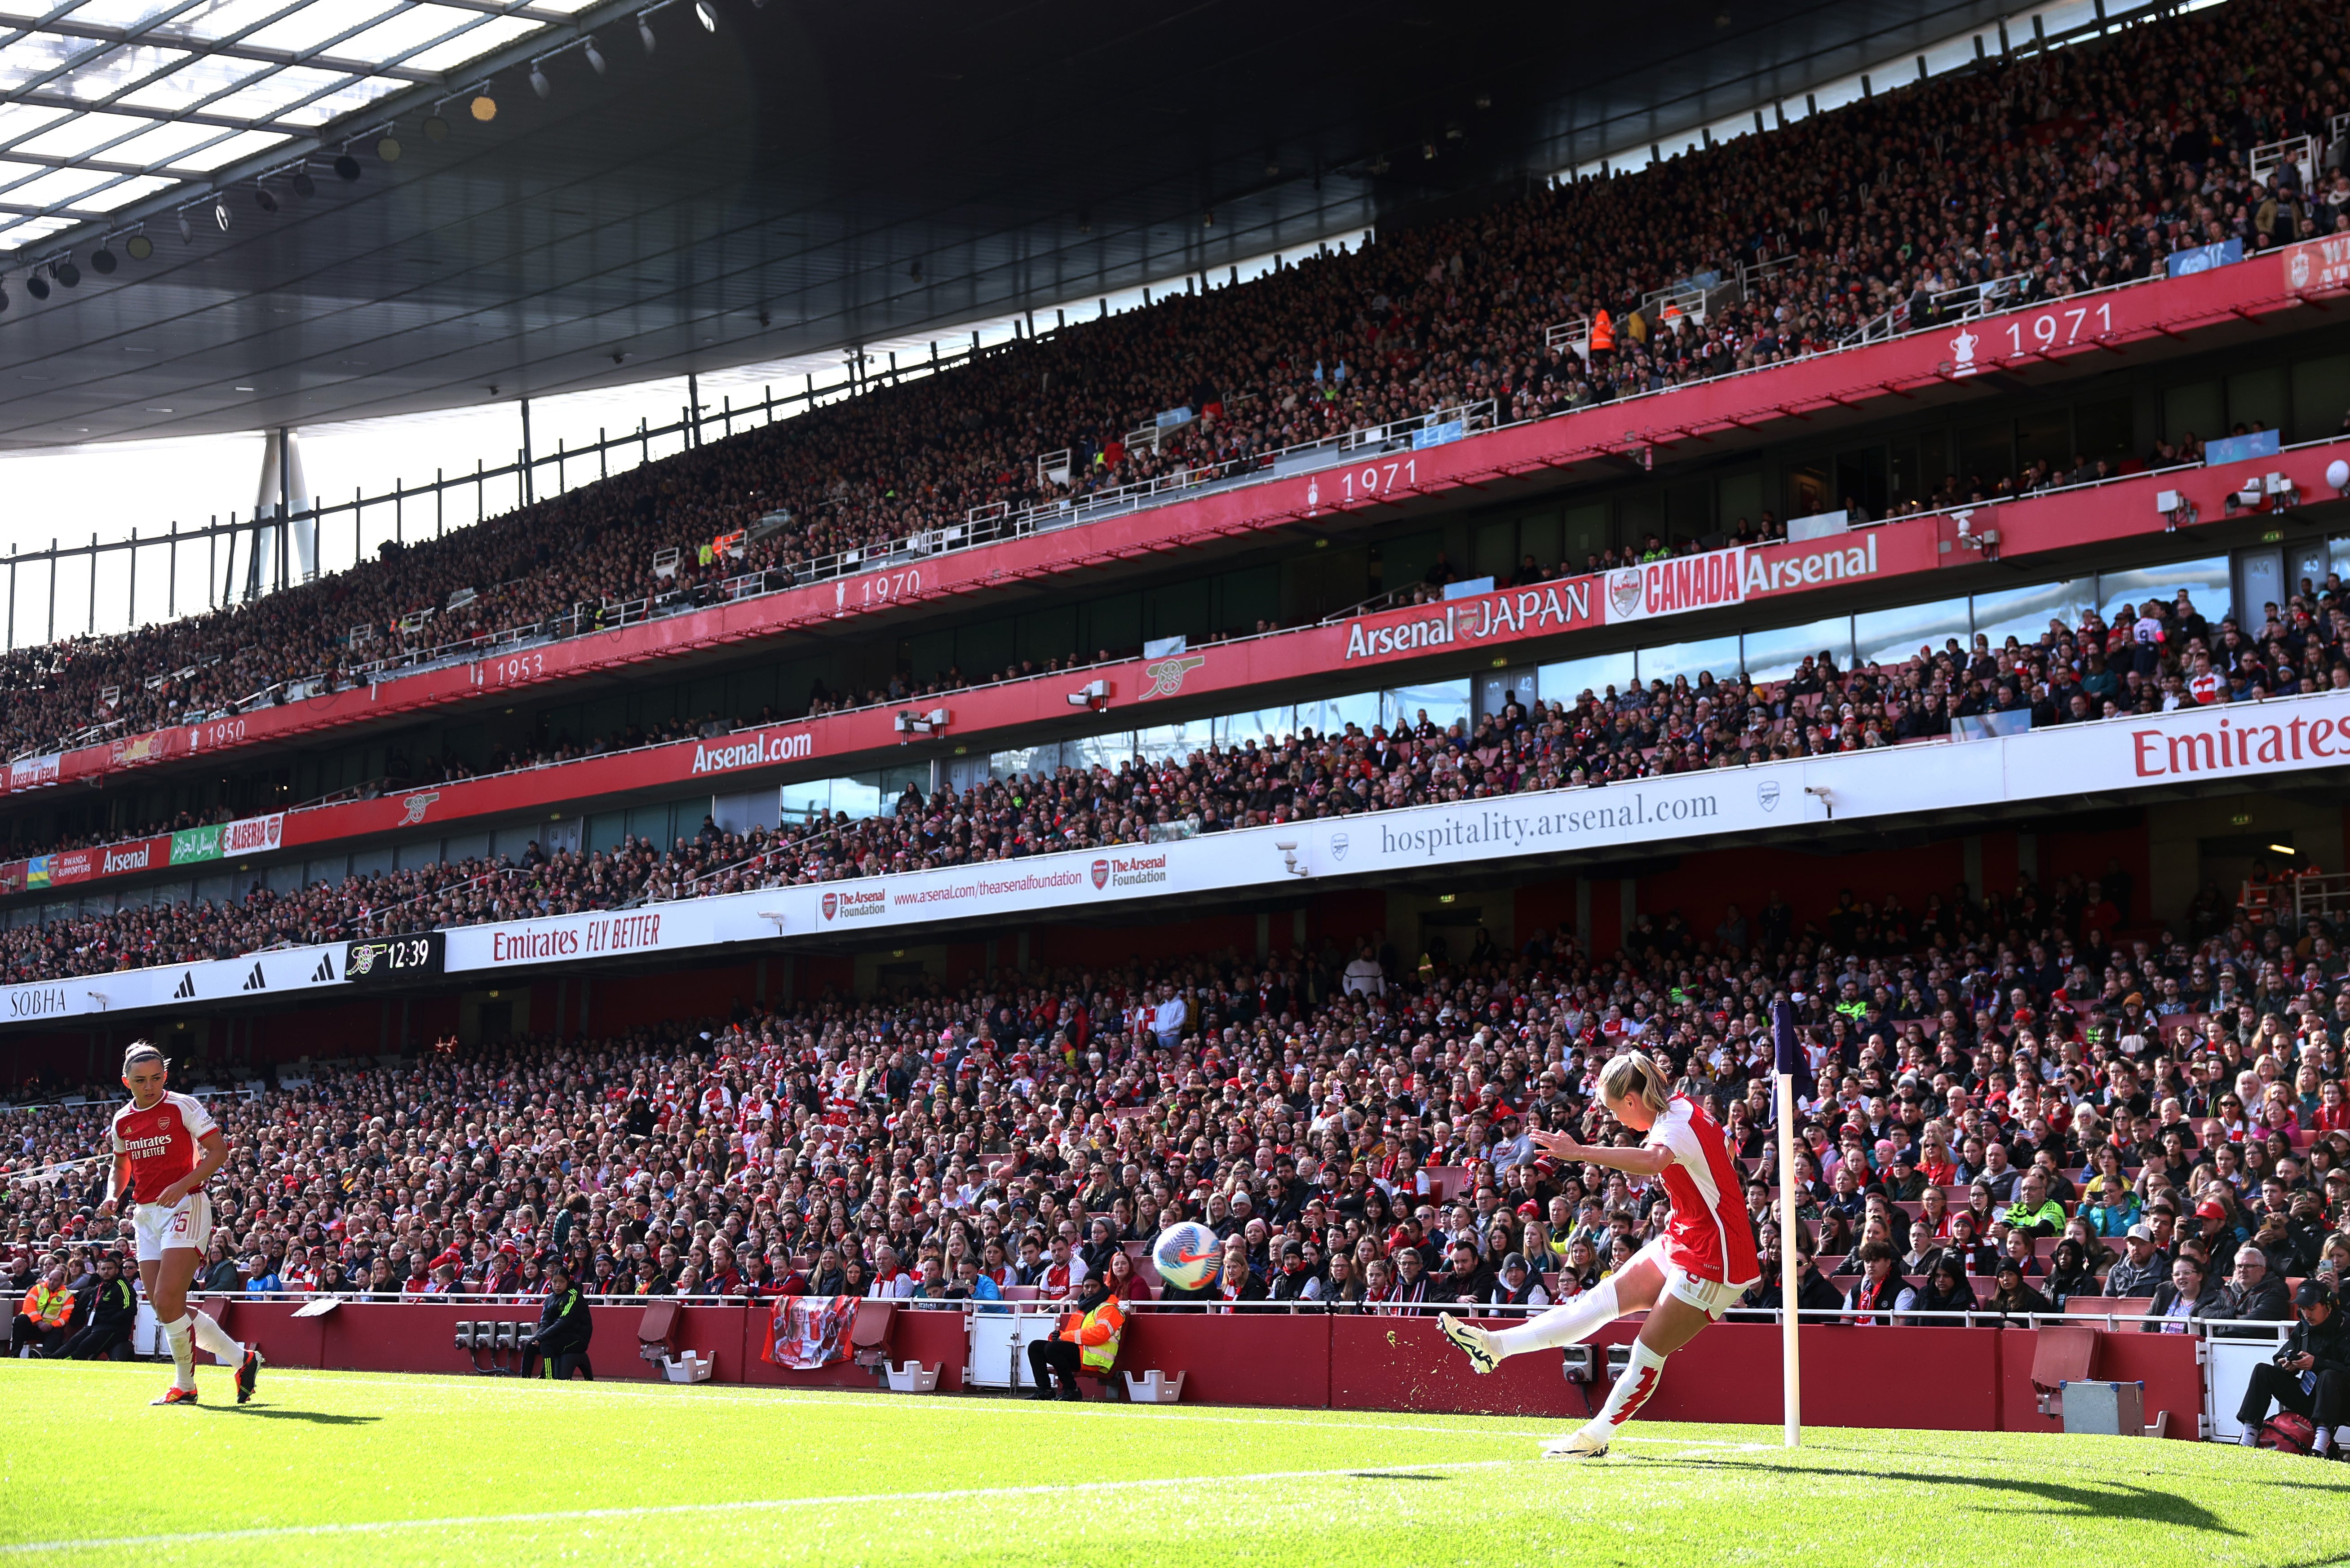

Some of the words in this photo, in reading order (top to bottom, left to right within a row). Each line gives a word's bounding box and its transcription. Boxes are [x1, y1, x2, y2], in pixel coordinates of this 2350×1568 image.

[2005, 302, 2115, 358] 1971
[1342, 459, 1415, 502] 1971
[1744, 533, 1877, 594] Arsenal
[862, 570, 920, 607] 1970
[1646, 552, 1739, 614] CANADA
[1345, 607, 1454, 660] Arsenal
[1474, 581, 1590, 638] JAPAN
[497, 654, 542, 686] 1953
[208, 720, 245, 748] 1950
[691, 733, 811, 774] Arsenal.com
[231, 821, 266, 850] ALGERIA
[1381, 793, 1719, 856] hospitality.arsenal.com
[58, 864, 91, 877] SUPPORTERS
[64, 855, 87, 865] RWANDA
[102, 843, 149, 874] Arsenal
[1111, 859, 1129, 873] The
[1129, 853, 1166, 871] Arsenal
[894, 870, 1082, 906] www.arsenal.com/thearsenalfoundation
[1112, 869, 1166, 887] Foundation
[839, 892, 854, 906] The
[854, 888, 885, 904] Arsenal
[840, 903, 885, 918] Foundation
[494, 927, 578, 961] Emirates
[586, 920, 609, 952] FLY
[611, 914, 660, 949] BETTER
[388, 939, 429, 969] 12:39
[9, 988, 66, 1018] SOBHA
[125, 1134, 172, 1151] Emirates
[131, 1150, 141, 1160] FLY
[142, 1146, 166, 1159] BETTER
[1703, 1263, 1720, 1271] HEAT.RDY
